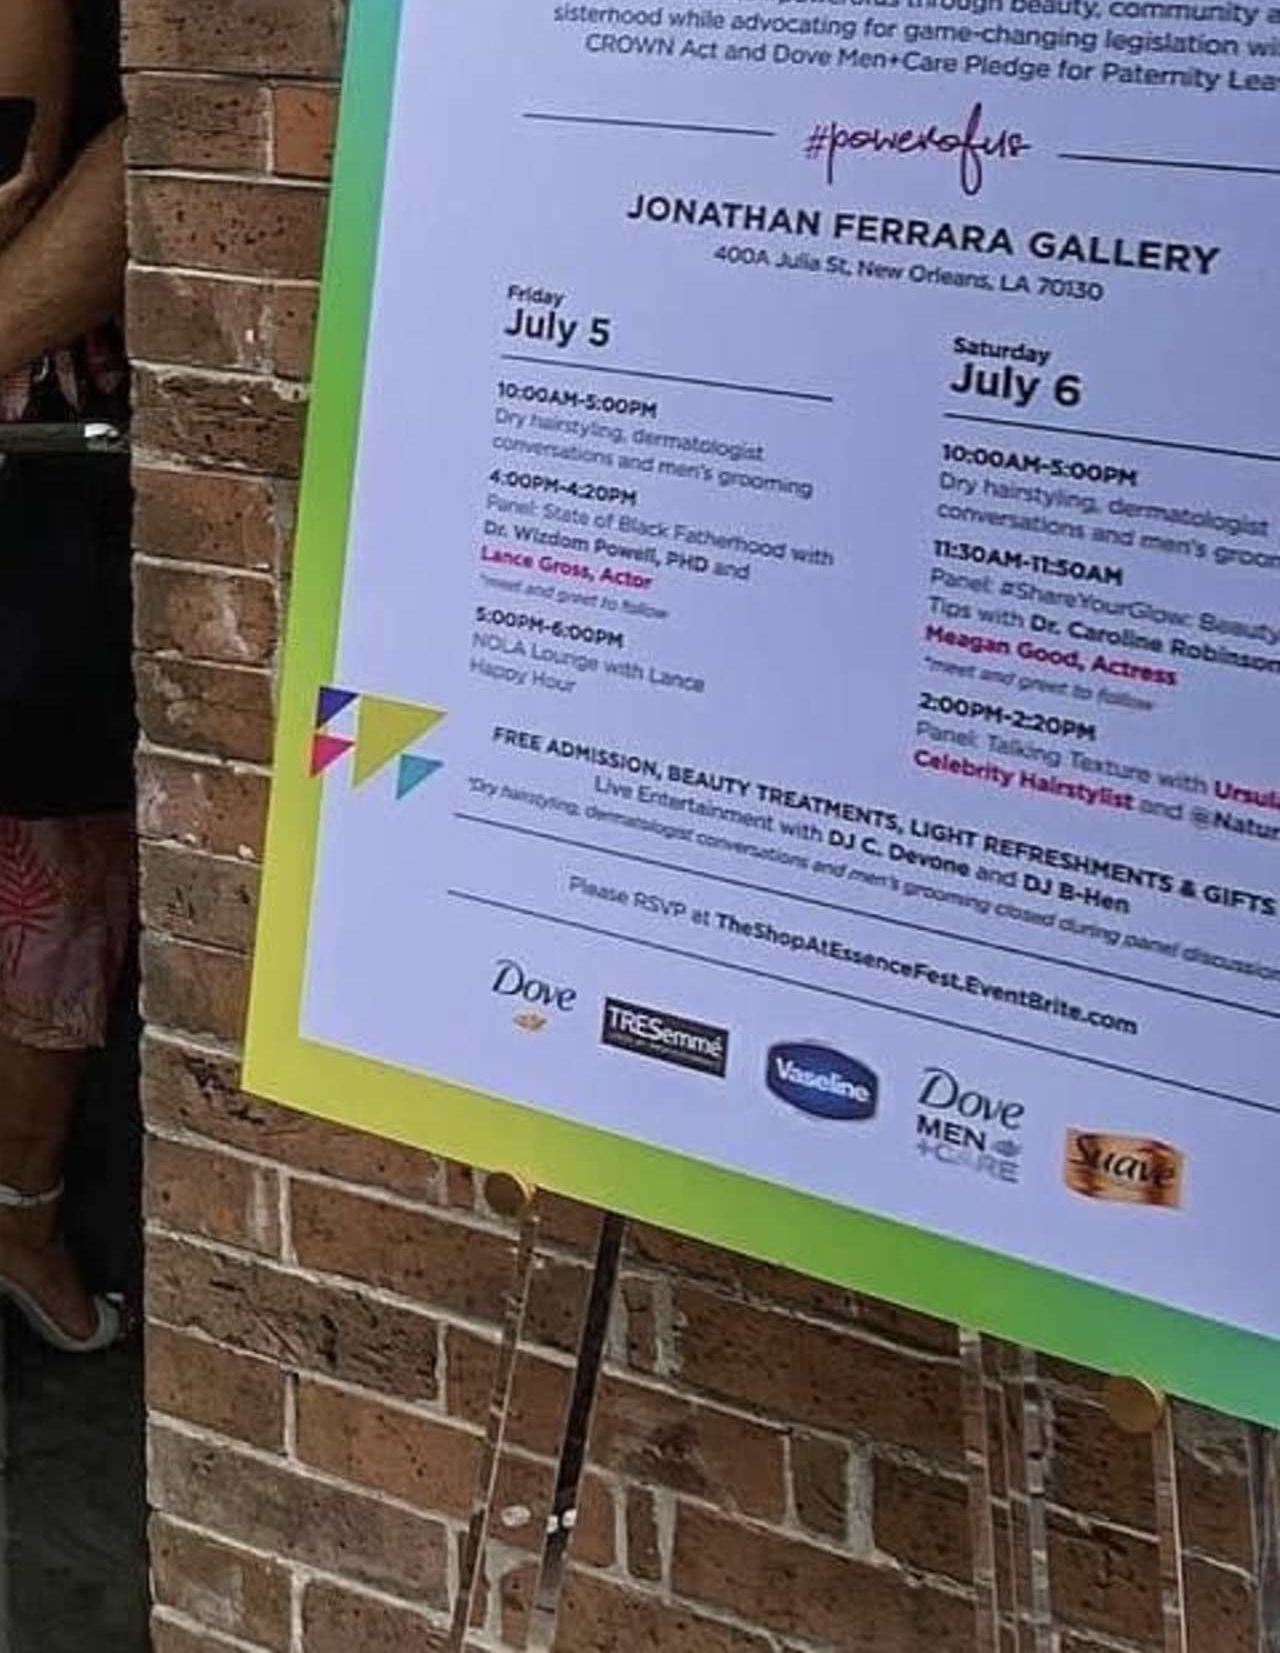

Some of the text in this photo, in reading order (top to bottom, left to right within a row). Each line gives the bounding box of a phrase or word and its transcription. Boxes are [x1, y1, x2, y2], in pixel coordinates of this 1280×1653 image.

[553, 3, 664, 28] sisterhood
[667, 8, 727, 31] while
[729, 12, 859, 41] advocating
[861, 15, 900, 40] for
[902, 21, 1100, 54] game-changing
[1102, 29, 1240, 57] legislation
[1107, 0, 1261, 28] community
[584, 32, 1280, 93] CROWN Act and Dove Men+Care Pledge for Paternity Lea
[627, 193, 1219, 274] JONATHAN FERRARA GALLERY
[505, 283, 566, 308] Friday
[712, 244, 1106, 302] 400A Julia St, New Orleans, LA 70130
[503, 307, 611, 349] July 5
[952, 336, 1052, 366] Saturday
[497, 382, 658, 418] 10:00AM-5:00PM
[949, 361, 1082, 408] July 6
[493, 404, 765, 463] Dry hairstyling, dermatologist
[489, 469, 638, 506] 4:00PM-4:20PM
[491, 434, 815, 500] conversations and men's grooming
[942, 444, 1139, 486] 10:00AM-5:00PM
[479, 544, 654, 591] Lance Gross, Actor
[933, 539, 1124, 586] 11:30AM-11:50AM
[475, 606, 625, 648] 5:00PM-6:00PM
[927, 594, 1280, 674] Tips with Dr. Caroline Robinson
[924, 624, 1178, 687] Meagan Good, Actress
[918, 692, 1097, 741] 2:00PM-2:20PM
[912, 749, 1016, 788] Celebrity
[1018, 770, 1135, 811] Hairstylist
[1137, 798, 1185, 822] and
[491, 726, 1278, 917] FREE ADMISSION, BEAUTY TREATMENTS, LIGHT REFRESHMENTS & GIFTS
[593, 774, 1132, 915] Live Entertainment with DJ C. Devone and DJ B-Hen
[568, 874, 630, 906] Please
[632, 891, 688, 918] RSVP
[689, 908, 711, 928] at
[490, 957, 578, 1013] Dove
[606, 1005, 725, 1059] TRESemmé
[774, 1056, 872, 1103] Vaseline
[916, 1065, 1026, 1130] Dove
[915, 1113, 988, 1153] MEN
[915, 1140, 1021, 1184] +CARE
[1069, 1133, 1176, 1188] Suave
